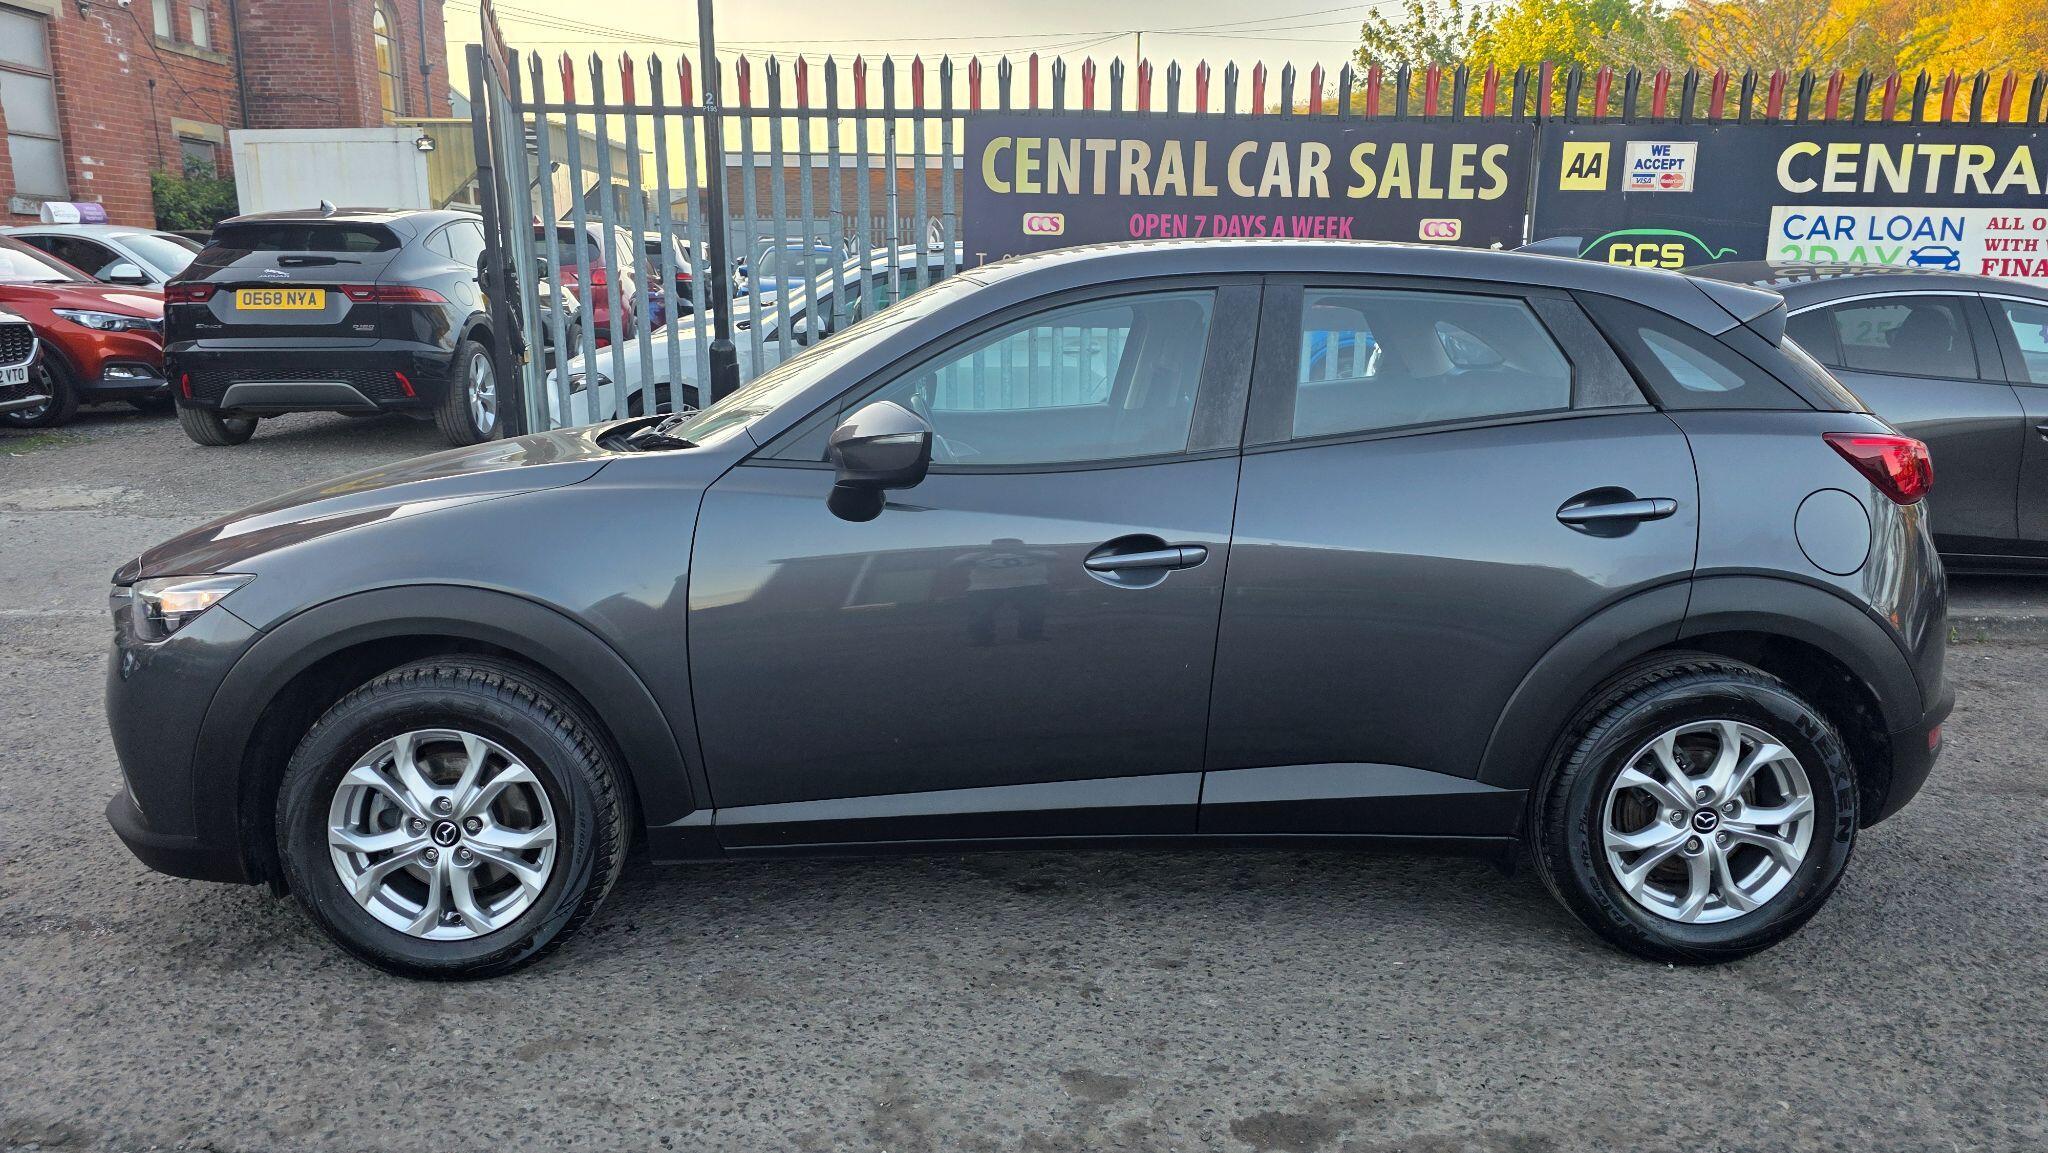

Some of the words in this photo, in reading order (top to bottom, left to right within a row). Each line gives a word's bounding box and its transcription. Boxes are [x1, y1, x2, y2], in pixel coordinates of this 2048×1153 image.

[705, 92, 714, 104] 2
[1651, 145, 1671, 156] WE
[982, 136, 1218, 197] CENTRAL
[1227, 140, 1332, 198] CAR
[1346, 142, 1509, 200] SALES
[1565, 152, 1602, 178] AA
[1633, 158, 1685, 170] ACCEPT
[1776, 141, 2048, 194] CENTRA
[1026, 215, 1060, 232] CCS
[1129, 214, 1188, 238] OPEN
[1192, 215, 1206, 238] 7
[1213, 215, 1266, 238] DAYS
[1272, 216, 1285, 238] A
[1292, 216, 1354, 239] WEEK
[1424, 221, 1457, 238] CCS
[1783, 214, 1856, 241] CAR
[1868, 215, 1965, 242] LOAN
[1986, 217, 2025, 231] ALL
[1985, 238, 2040, 252] WITH
[1608, 243, 1685, 268] CCS
[242, 292, 282, 305] OE68
[286, 291, 317, 305] NYA
[6, 368, 24, 382] VTO
